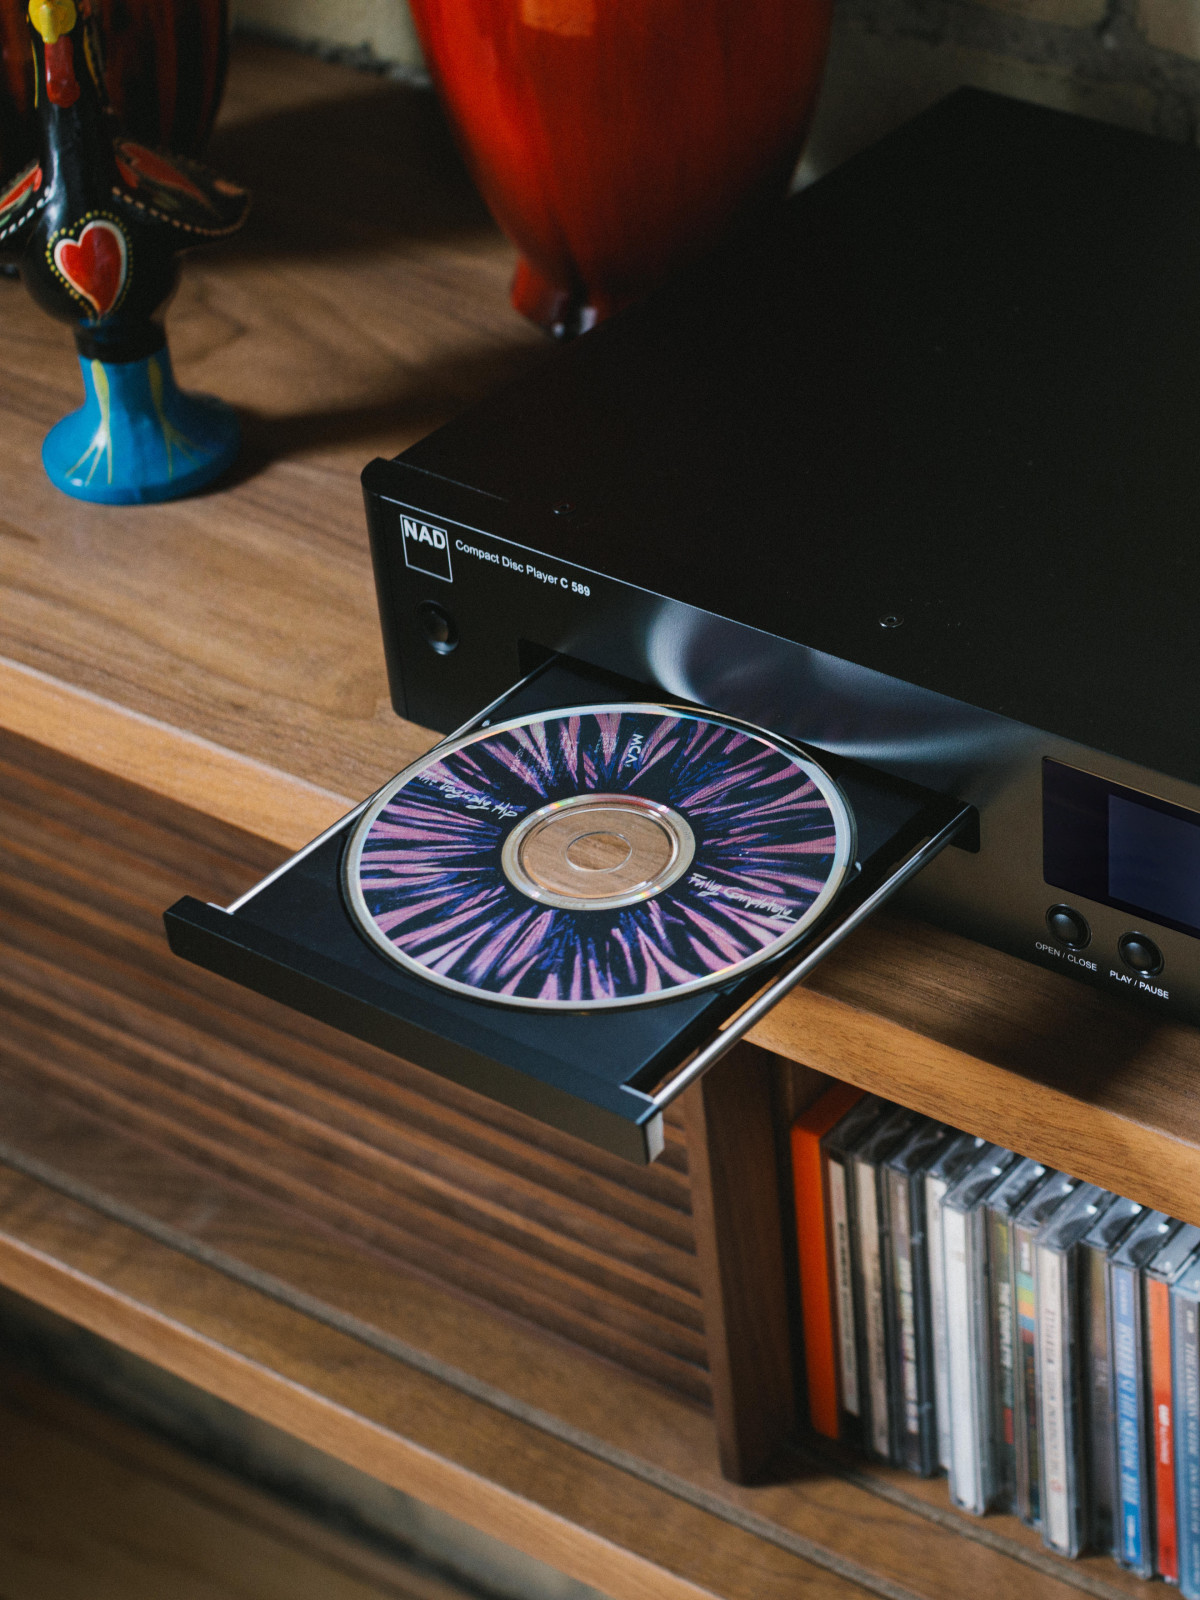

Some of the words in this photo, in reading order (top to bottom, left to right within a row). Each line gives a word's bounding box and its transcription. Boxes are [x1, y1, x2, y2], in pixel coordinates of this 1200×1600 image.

[403, 518, 447, 549] NAD
[455, 539, 500, 564] Compact
[502, 556, 525, 573] Disc
[526, 565, 558, 585] Player
[559, 577, 569, 589] C
[571, 581, 591, 597] 589
[625, 733, 644, 765] MCA
[491, 801, 518, 820] Hip
[687, 872, 722, 897] Fully
[1035, 941, 1060, 958] OPEN
[1067, 954, 1098, 972] CLOSE
[1109, 969, 1133, 985] PLAY
[1139, 981, 1170, 999] PAUSE
